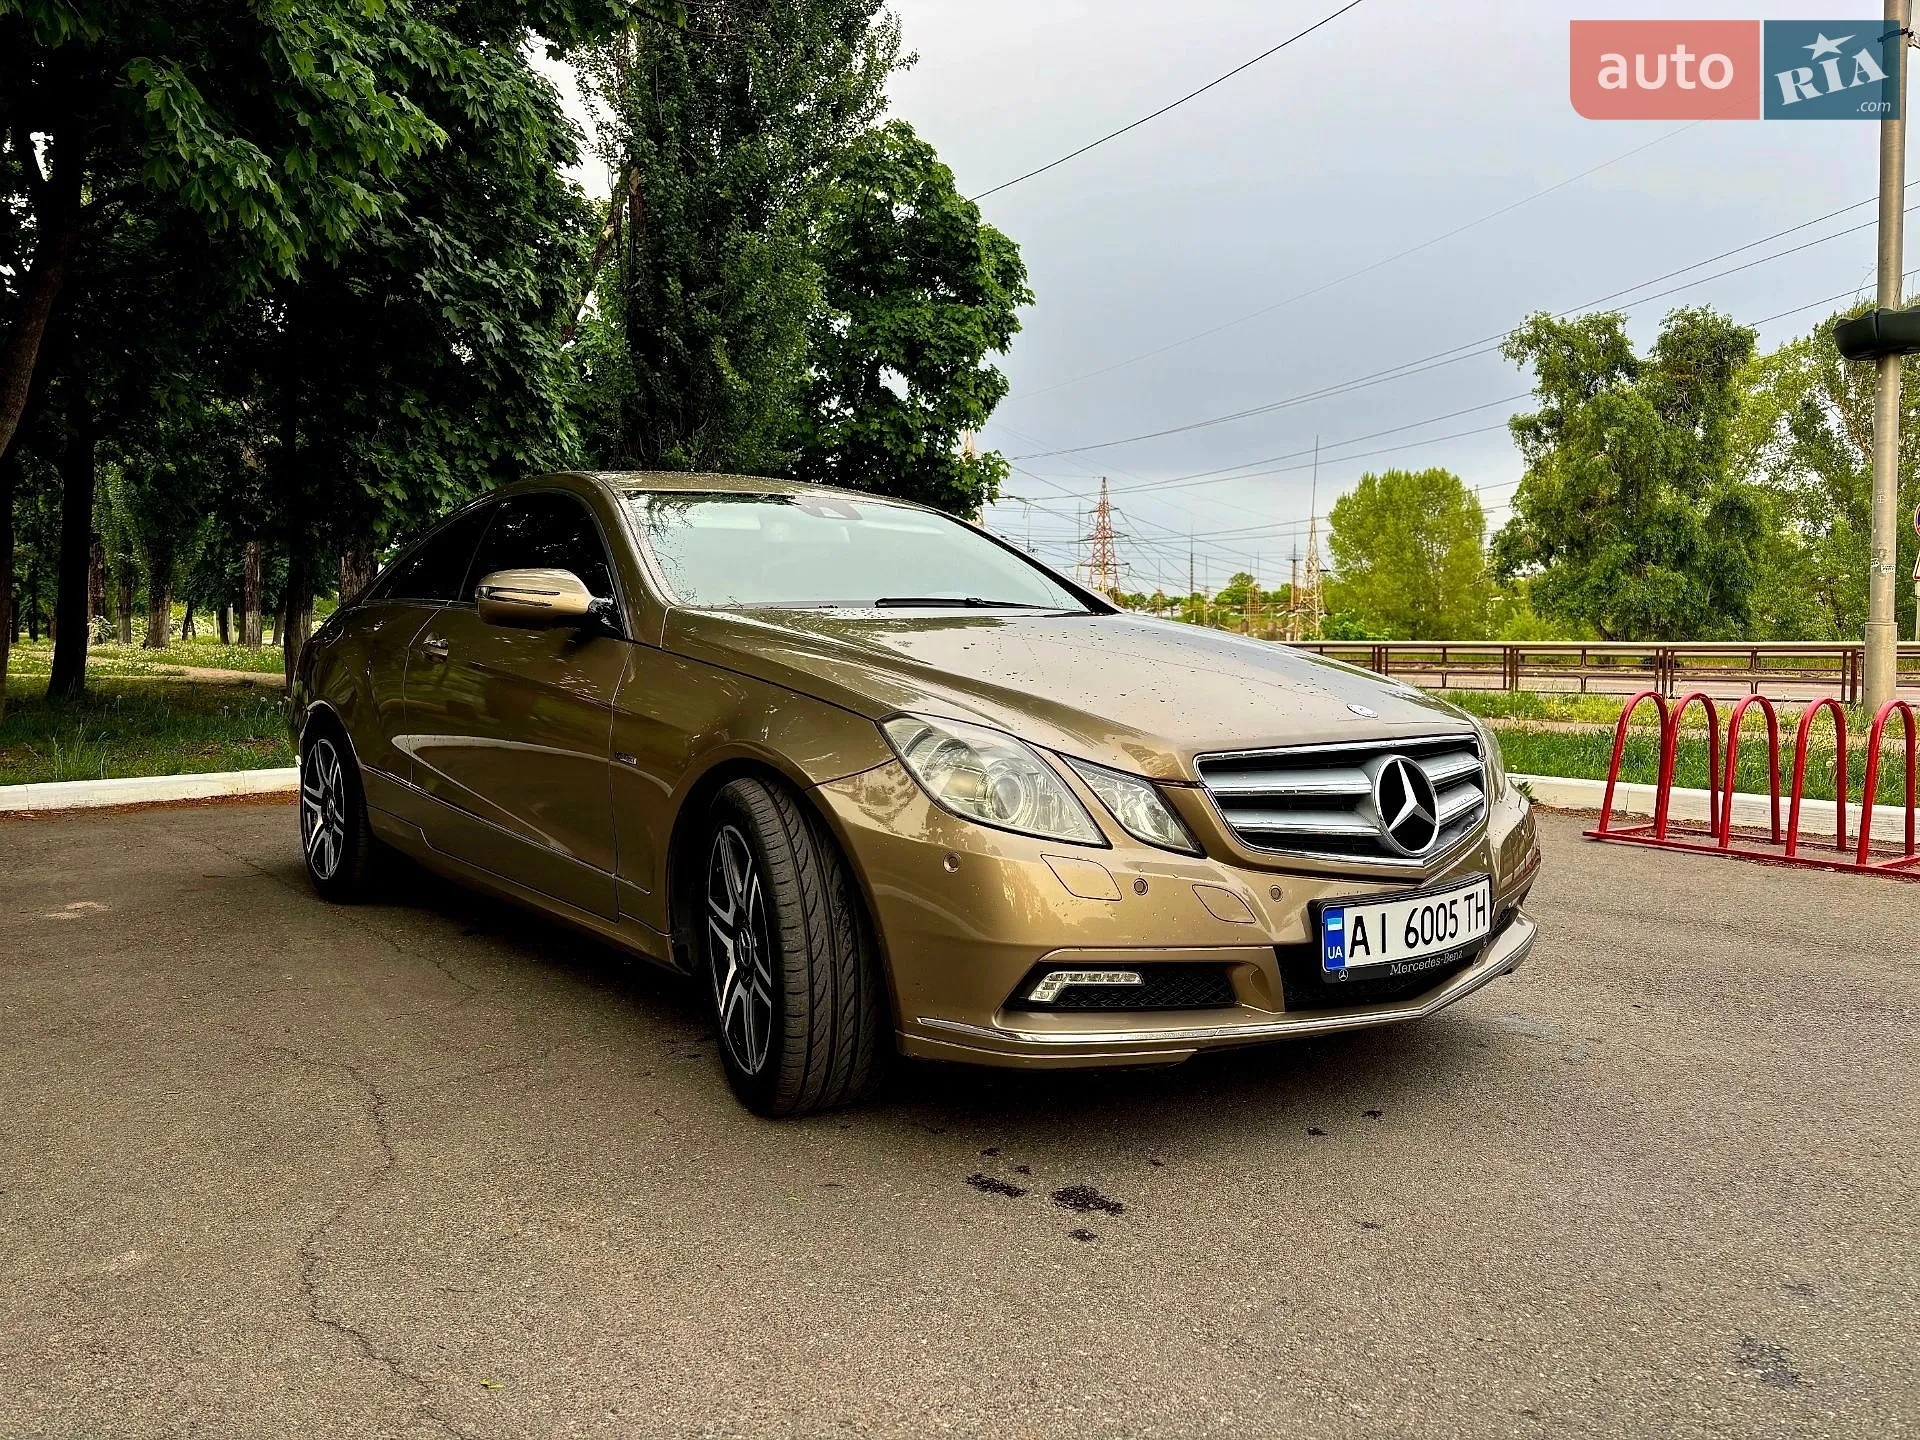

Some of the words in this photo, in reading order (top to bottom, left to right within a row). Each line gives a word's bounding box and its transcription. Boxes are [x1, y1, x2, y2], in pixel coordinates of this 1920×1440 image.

[1404, 899, 1459, 949] 6005
[1464, 888, 1486, 933] TH
[1327, 946, 1343, 960] UA
[1390, 949, 1463, 976] Mercedes-Benz
